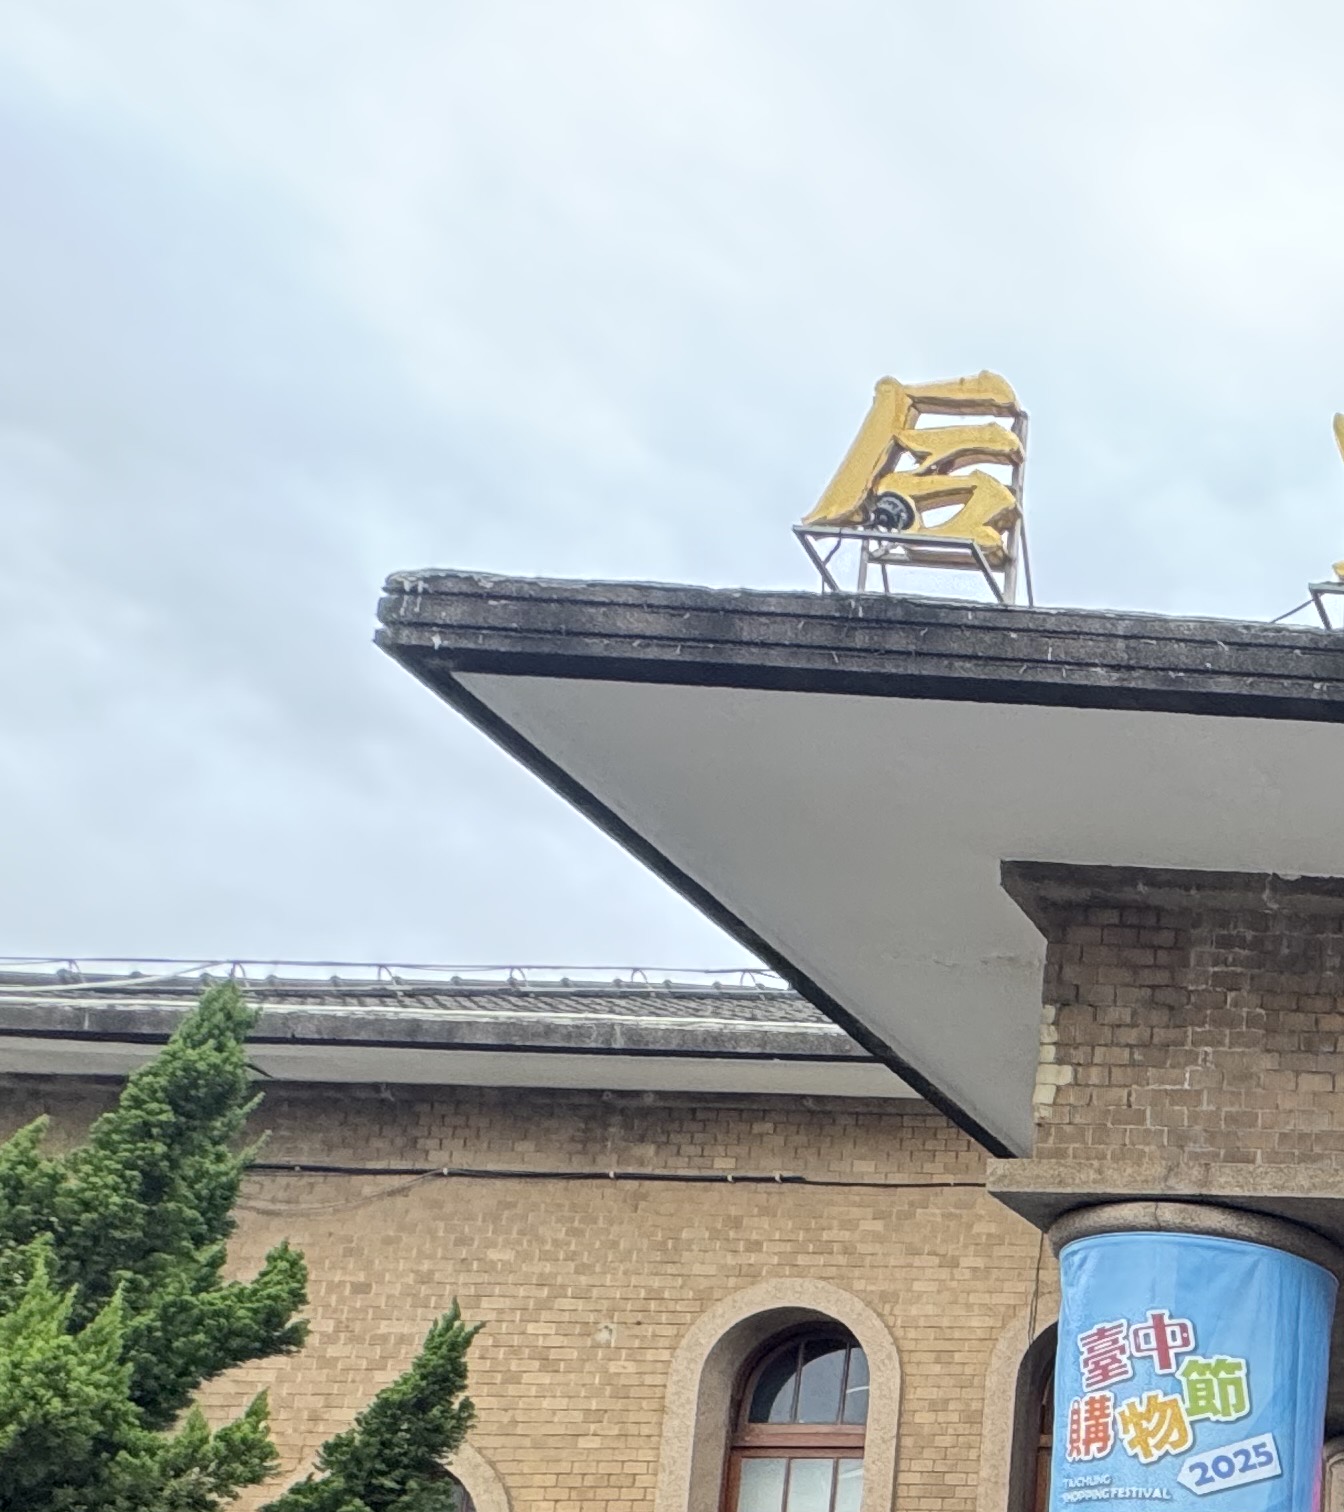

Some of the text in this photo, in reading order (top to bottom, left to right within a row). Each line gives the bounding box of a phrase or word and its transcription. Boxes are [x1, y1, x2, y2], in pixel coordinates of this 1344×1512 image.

[1079, 1311, 1194, 1390] 臺中
[1067, 1357, 1250, 1462] 購物節
[1111, 1486, 1172, 1500] FESTIVAL
[1188, 1441, 1274, 1487] 2025
